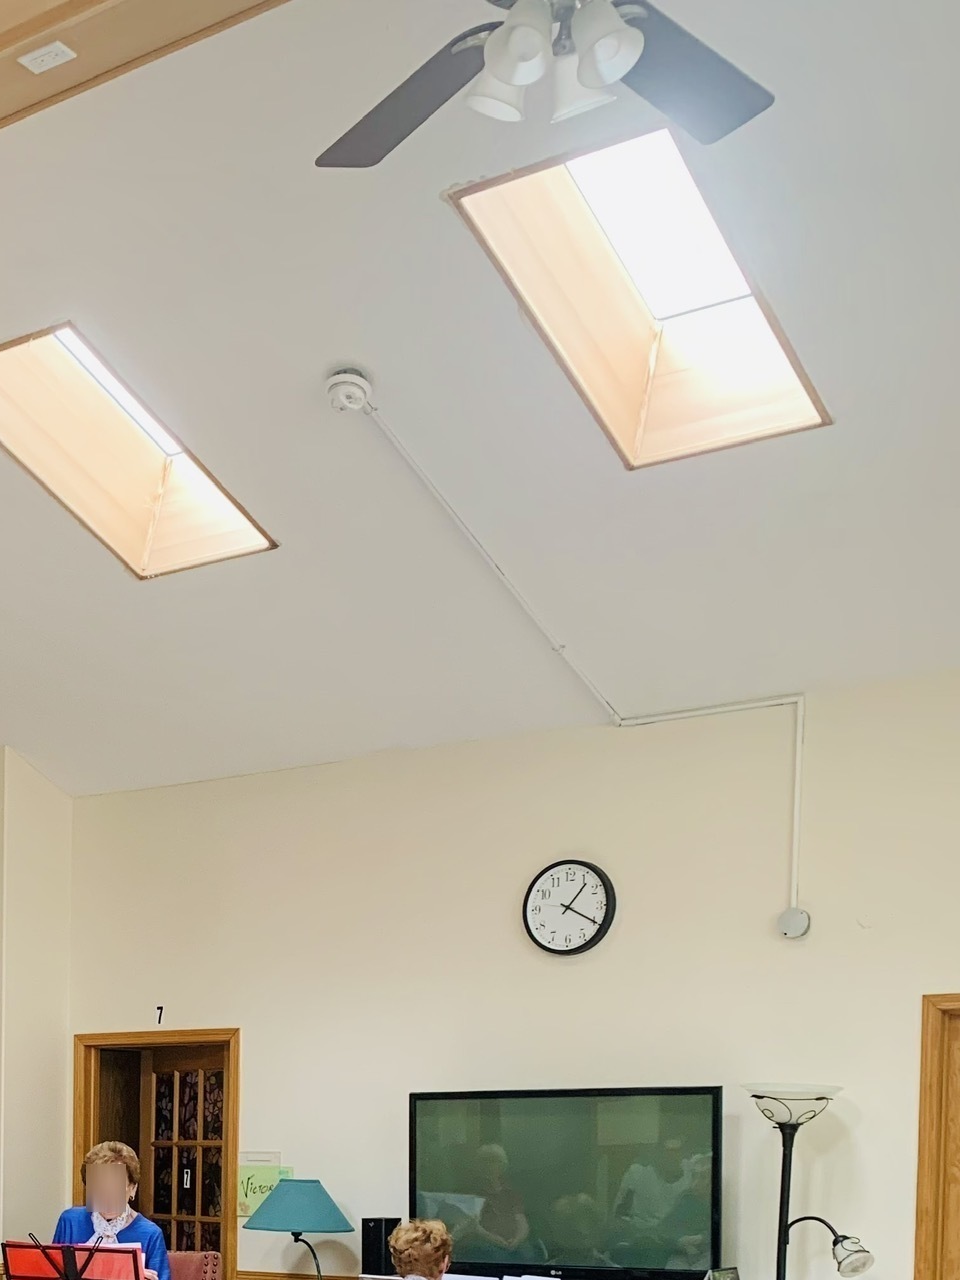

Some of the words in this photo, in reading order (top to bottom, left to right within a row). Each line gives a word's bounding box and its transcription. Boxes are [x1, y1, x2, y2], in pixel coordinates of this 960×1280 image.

[566, 871, 576, 882] 12
[551, 877, 560, 888] 11
[541, 889, 551, 900] 10
[591, 884, 598, 895] 2
[534, 905, 541, 915] 9
[596, 901, 603, 911] 3
[540, 920, 546, 930] 8
[550, 931, 556, 941] 7
[565, 934, 571, 944] 6
[579, 928, 586, 939] 5
[156, 1006, 163, 1024] 7
